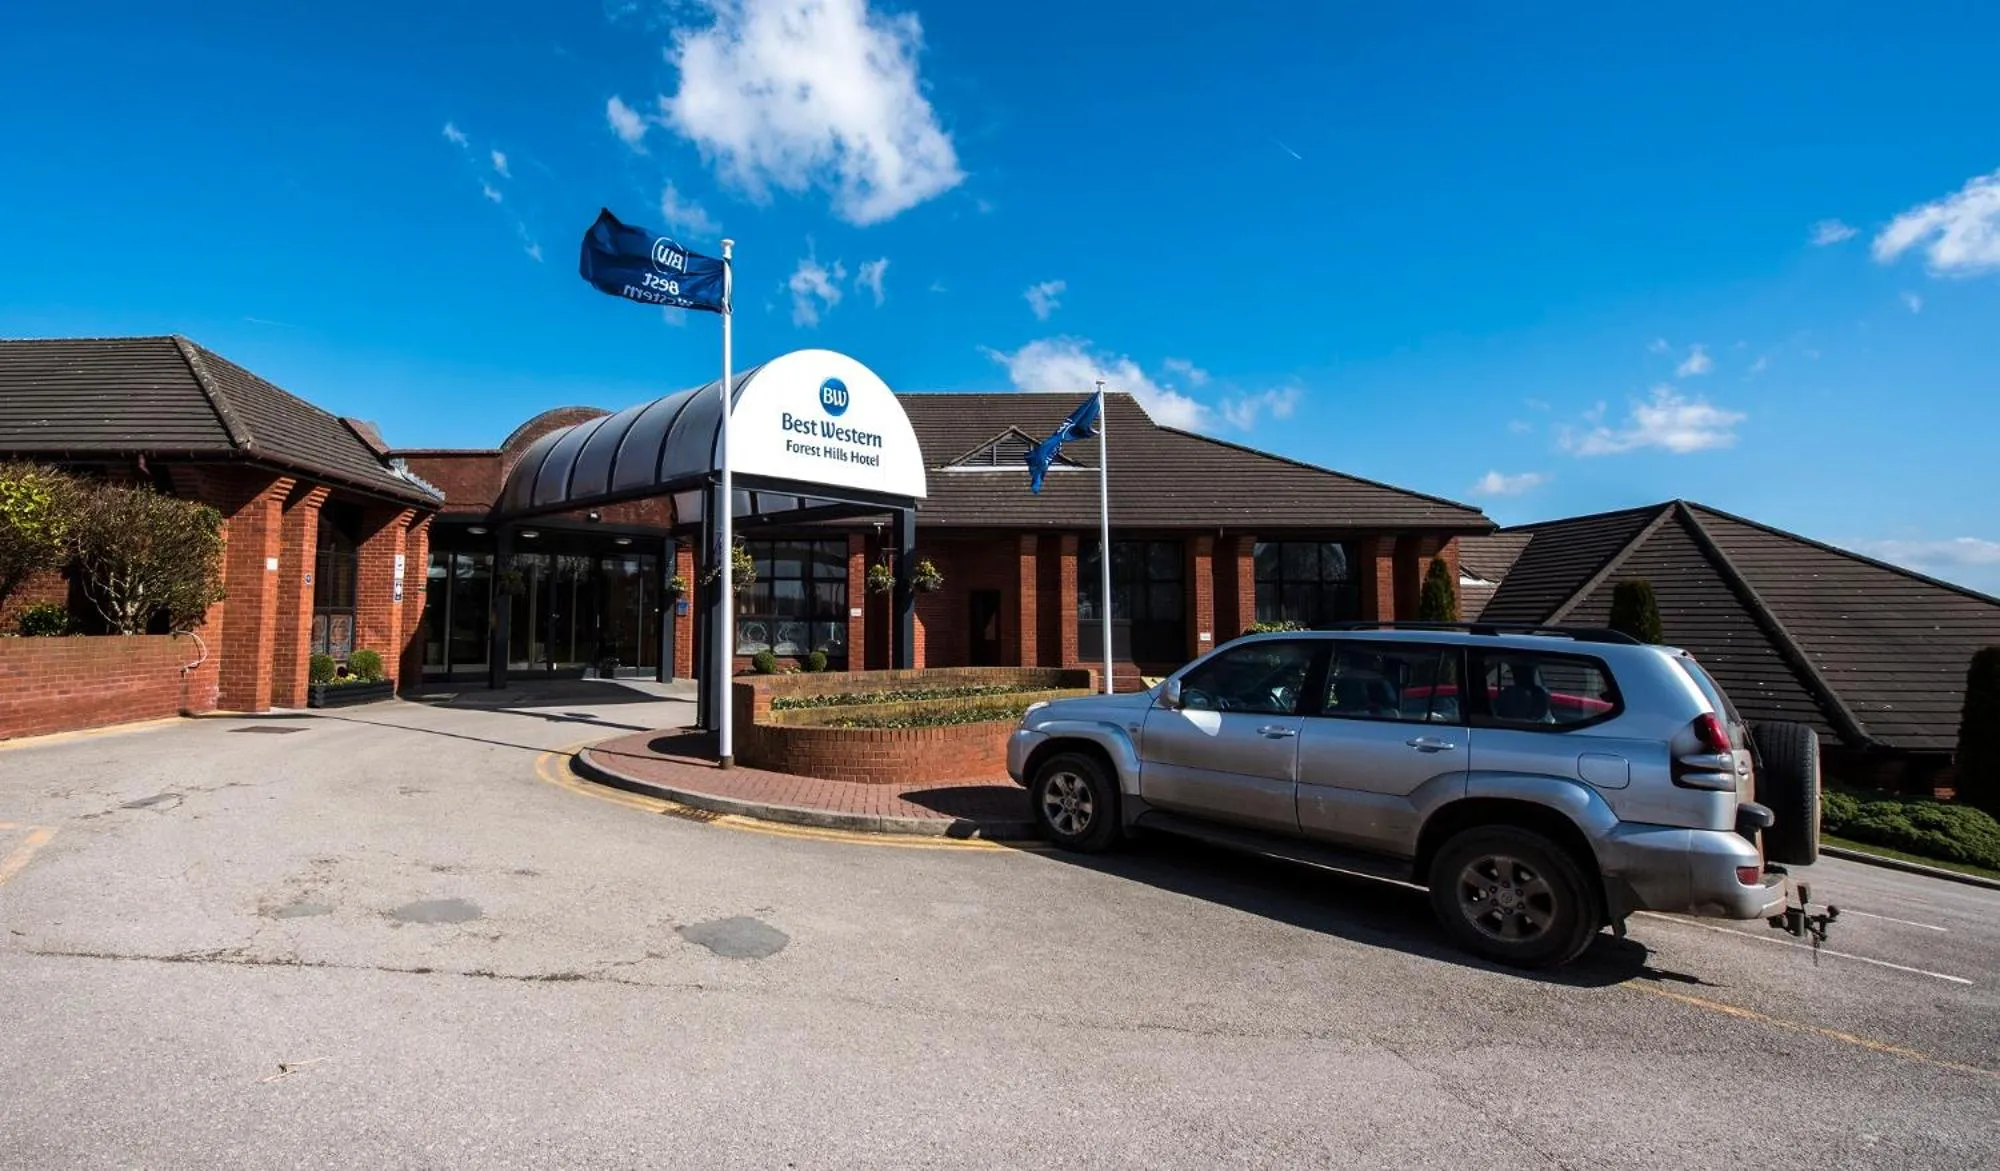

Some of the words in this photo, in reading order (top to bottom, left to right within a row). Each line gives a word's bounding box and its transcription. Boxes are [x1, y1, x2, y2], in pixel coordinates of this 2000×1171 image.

[823, 387, 847, 407] BW
[782, 412, 817, 436] Best
[820, 421, 882, 448] Western
[786, 439, 820, 457] Forest
[823, 446, 848, 462] Hills
[851, 451, 880, 467] Hotel
